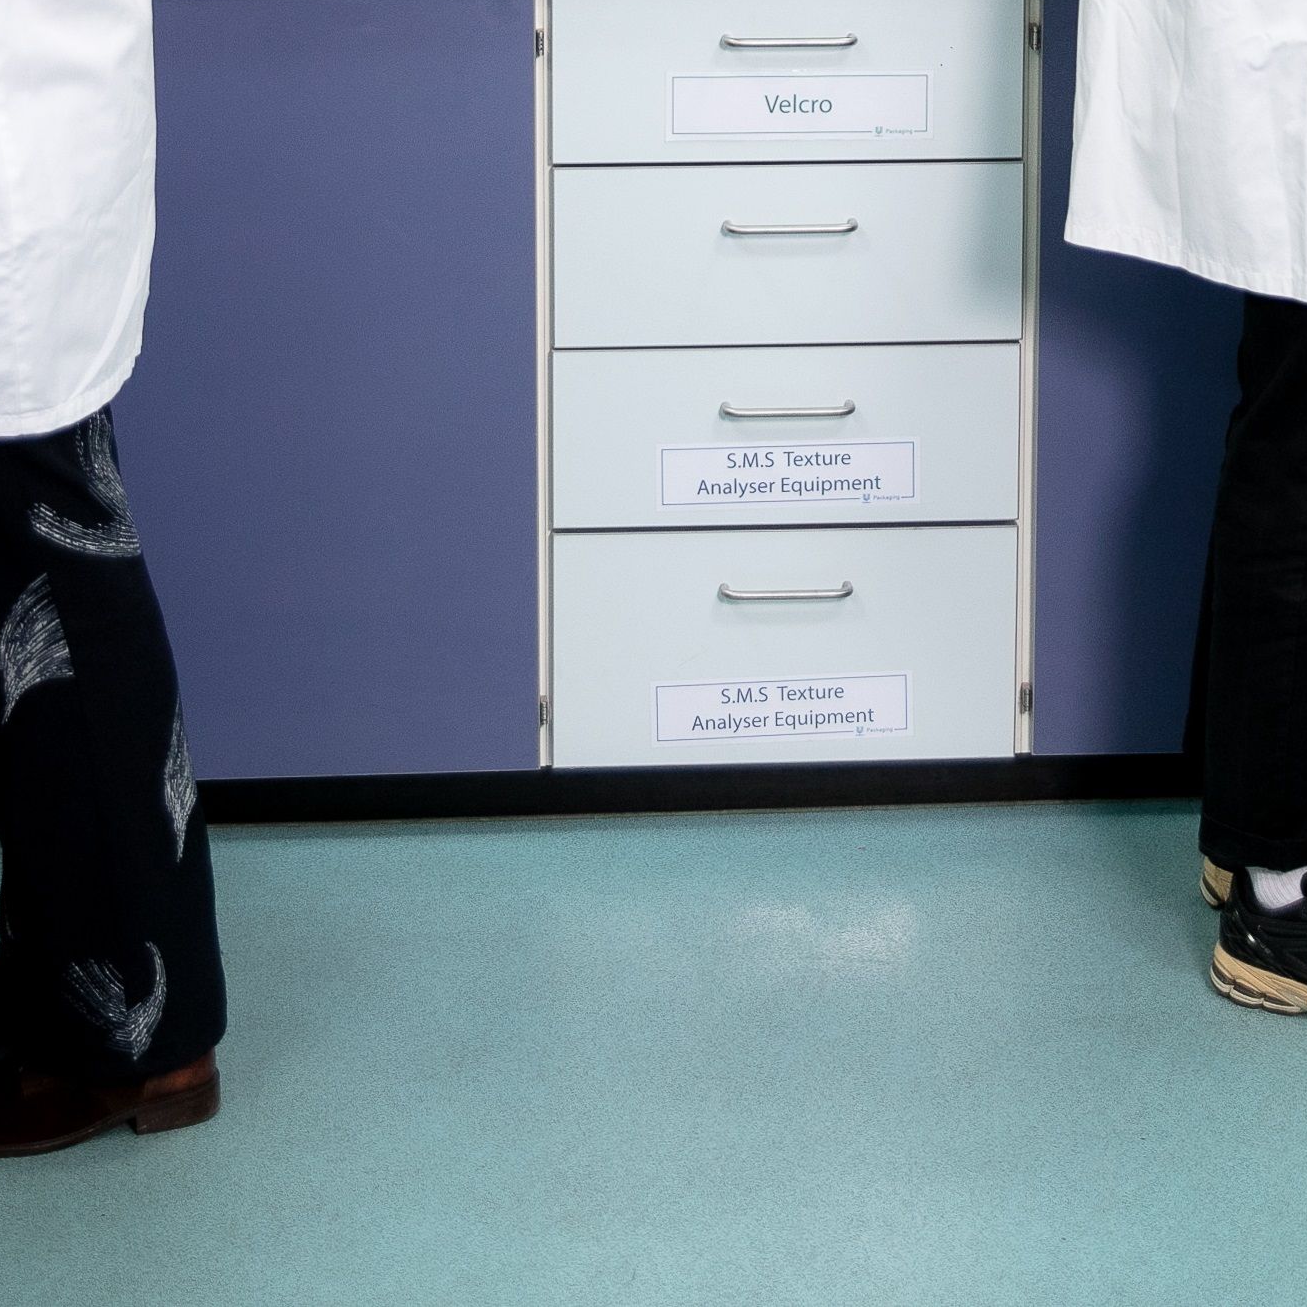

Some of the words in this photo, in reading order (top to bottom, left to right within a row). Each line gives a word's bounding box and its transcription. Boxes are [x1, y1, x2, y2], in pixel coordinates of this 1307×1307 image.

[764, 94, 833, 114] Velcro
[885, 127, 913, 135] Packaging
[726, 451, 775, 469] S.M.S
[783, 450, 851, 467] Texture
[697, 478, 775, 498] Analyser
[780, 475, 881, 496] Equipment
[721, 686, 769, 705] S.M.S
[777, 684, 845, 702] Texture
[692, 713, 769, 733] Analyser
[775, 708, 875, 730] Equipment
